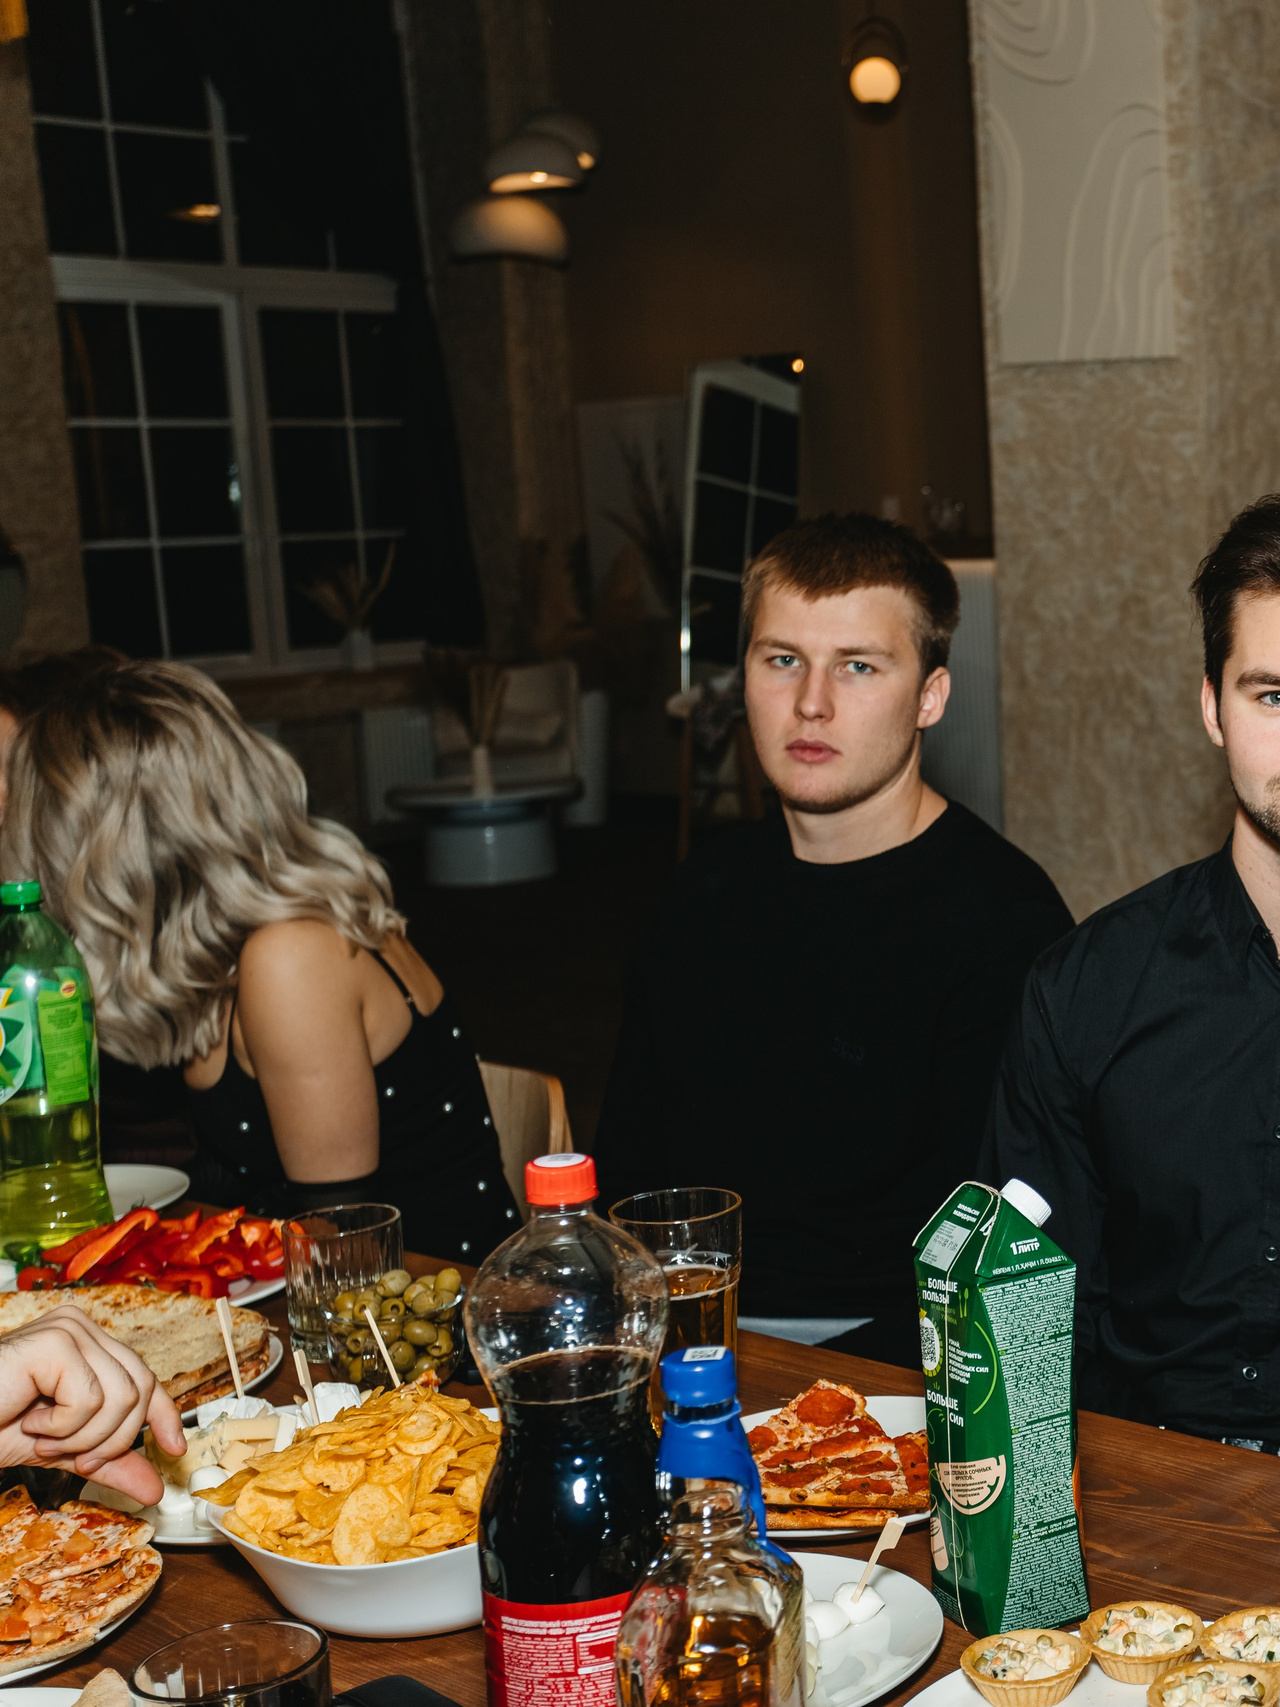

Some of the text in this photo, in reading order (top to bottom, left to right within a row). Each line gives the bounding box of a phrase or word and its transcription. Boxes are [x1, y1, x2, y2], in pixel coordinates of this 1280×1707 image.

[1010, 1242, 1018, 1255] 1
[1018, 1242, 1040, 1254] ЛИТР
[927, 1277, 958, 1293] БОЛЬШЕ
[922, 1289, 950, 1305] ПОЛЬЗЫ
[926, 1389, 959, 1411] БОЛЬШЕ
[949, 1412, 964, 1427] СИЛ
